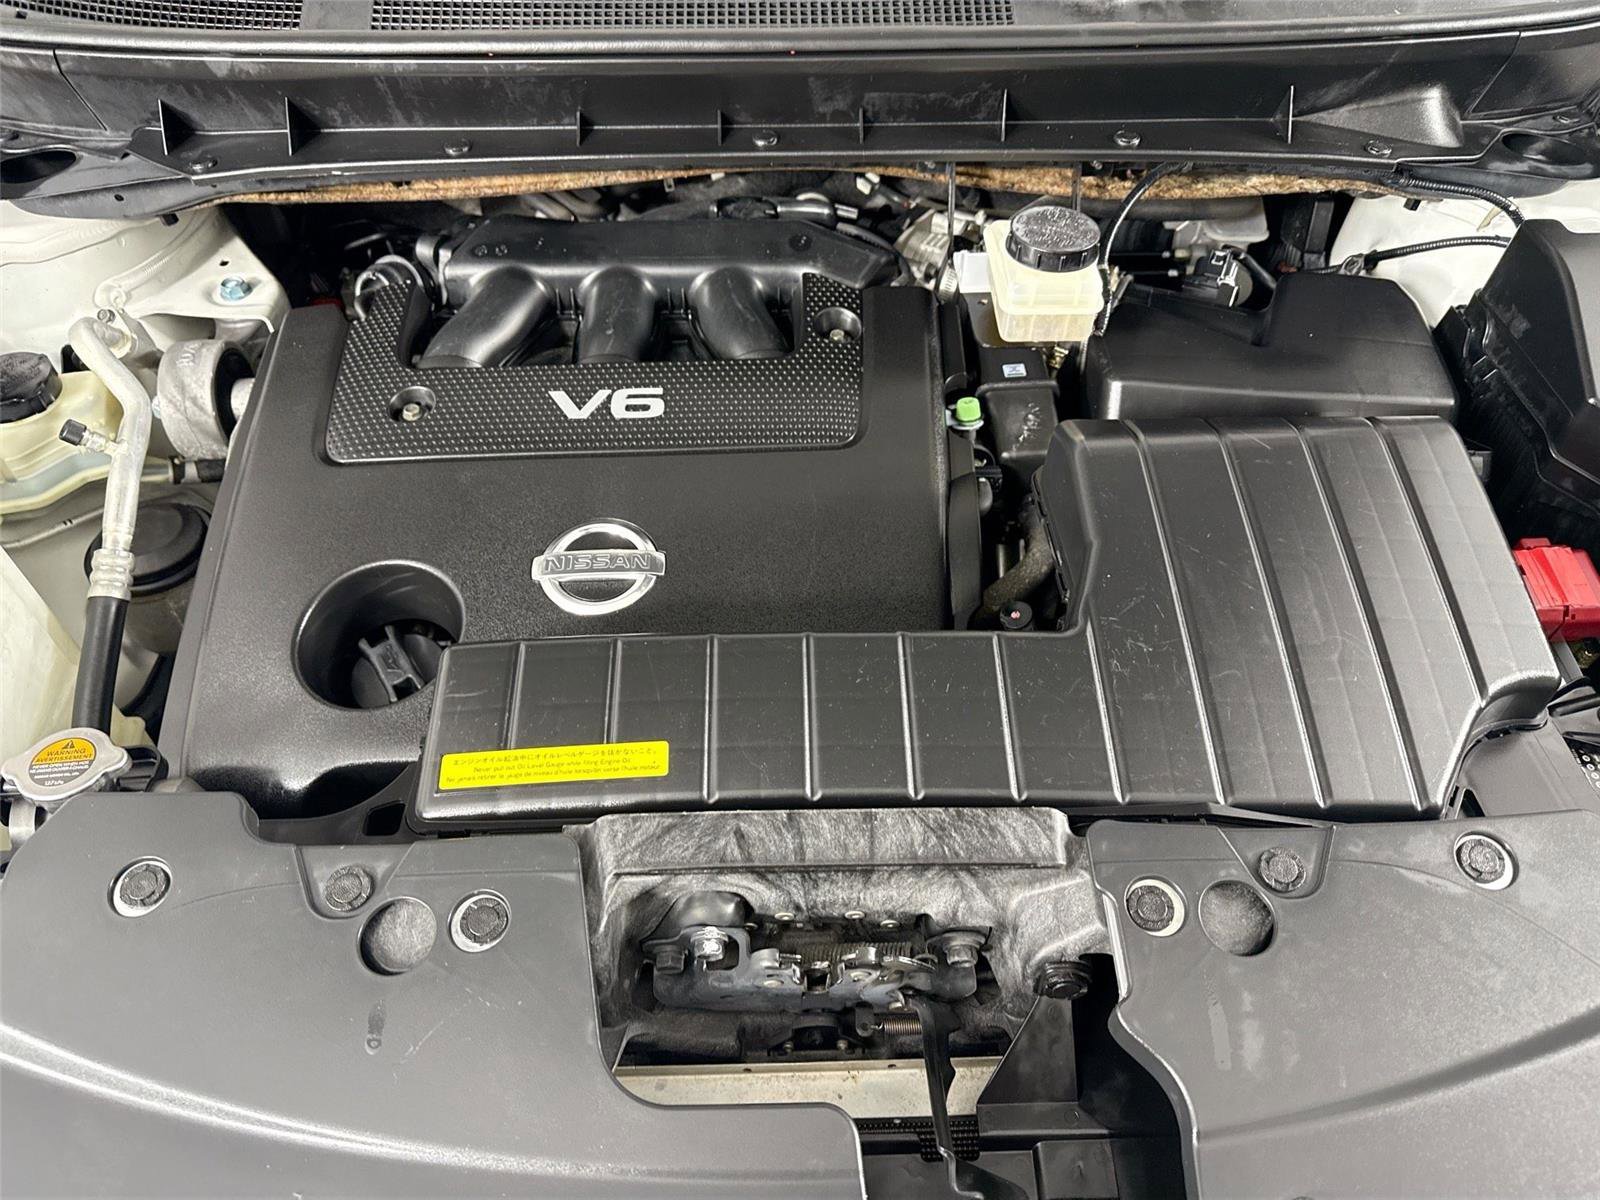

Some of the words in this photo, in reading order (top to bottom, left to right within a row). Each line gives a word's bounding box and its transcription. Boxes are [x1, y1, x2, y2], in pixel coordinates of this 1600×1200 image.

[547, 387, 665, 420] V6
[544, 554, 651, 572] NISSAN
[35, 753, 92, 763] AVERTISSEMENT
[46, 748, 86, 757] WARNING
